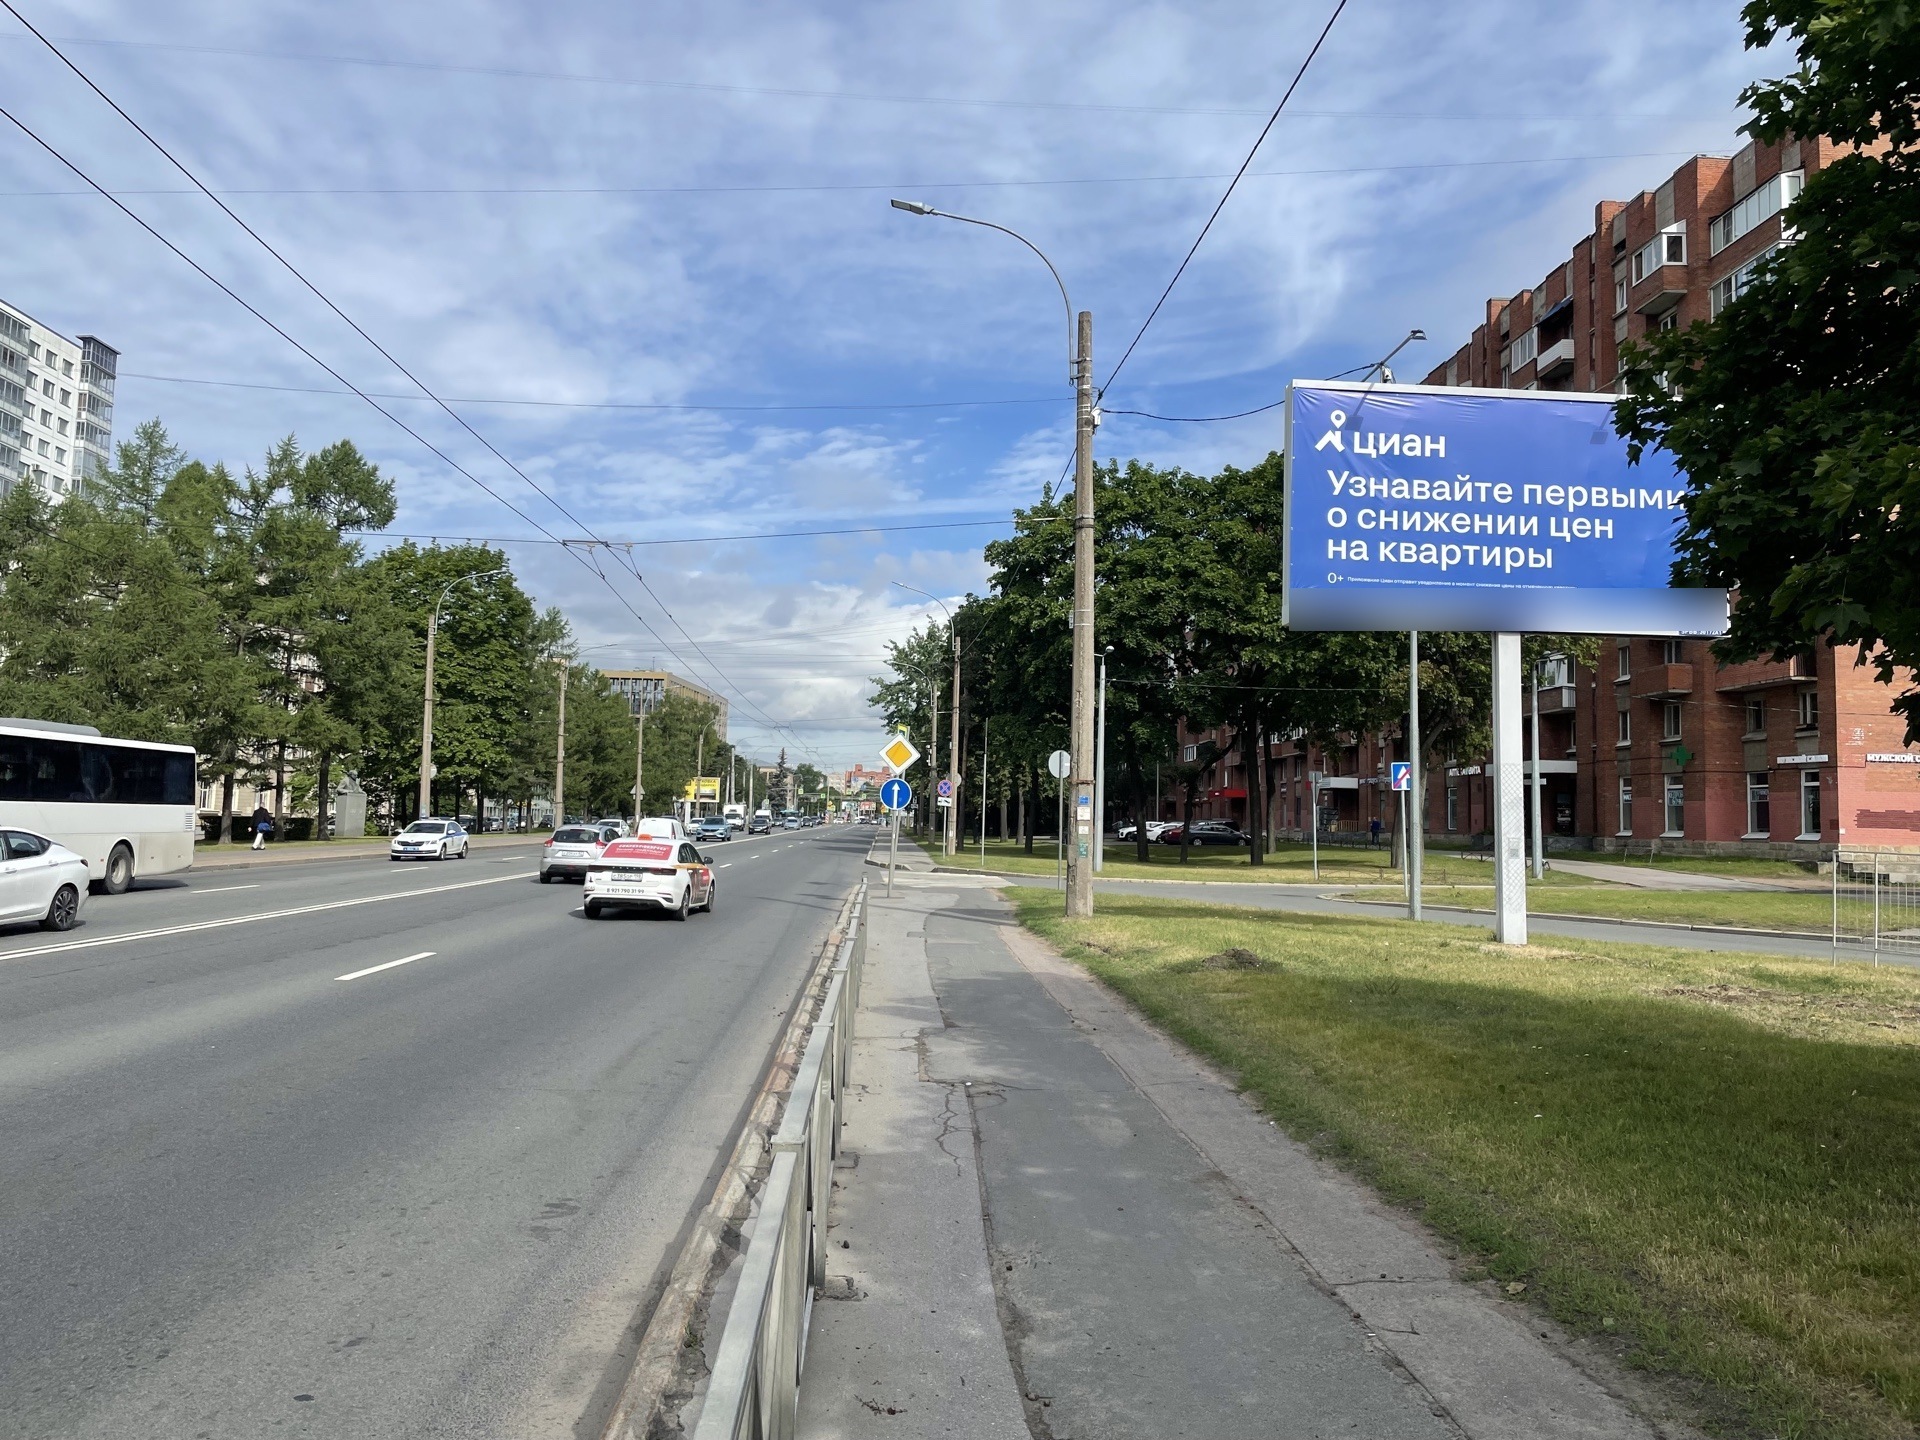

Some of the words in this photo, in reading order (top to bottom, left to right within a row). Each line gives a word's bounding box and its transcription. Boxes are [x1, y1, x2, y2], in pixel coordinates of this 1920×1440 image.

[1354, 429, 1446, 459] циан
[1326, 469, 1513, 505] Узнавайте
[1523, 484, 1686, 513] первыми
[1327, 507, 1348, 528] о
[1357, 508, 1539, 537] снижении
[1549, 516, 1614, 543] цен
[1327, 538, 1370, 561] на
[1379, 541, 1554, 574] квартиры
[1327, 572, 1344, 584] 0+
[1867, 753, 1914, 763] МУЖСКОЙ
